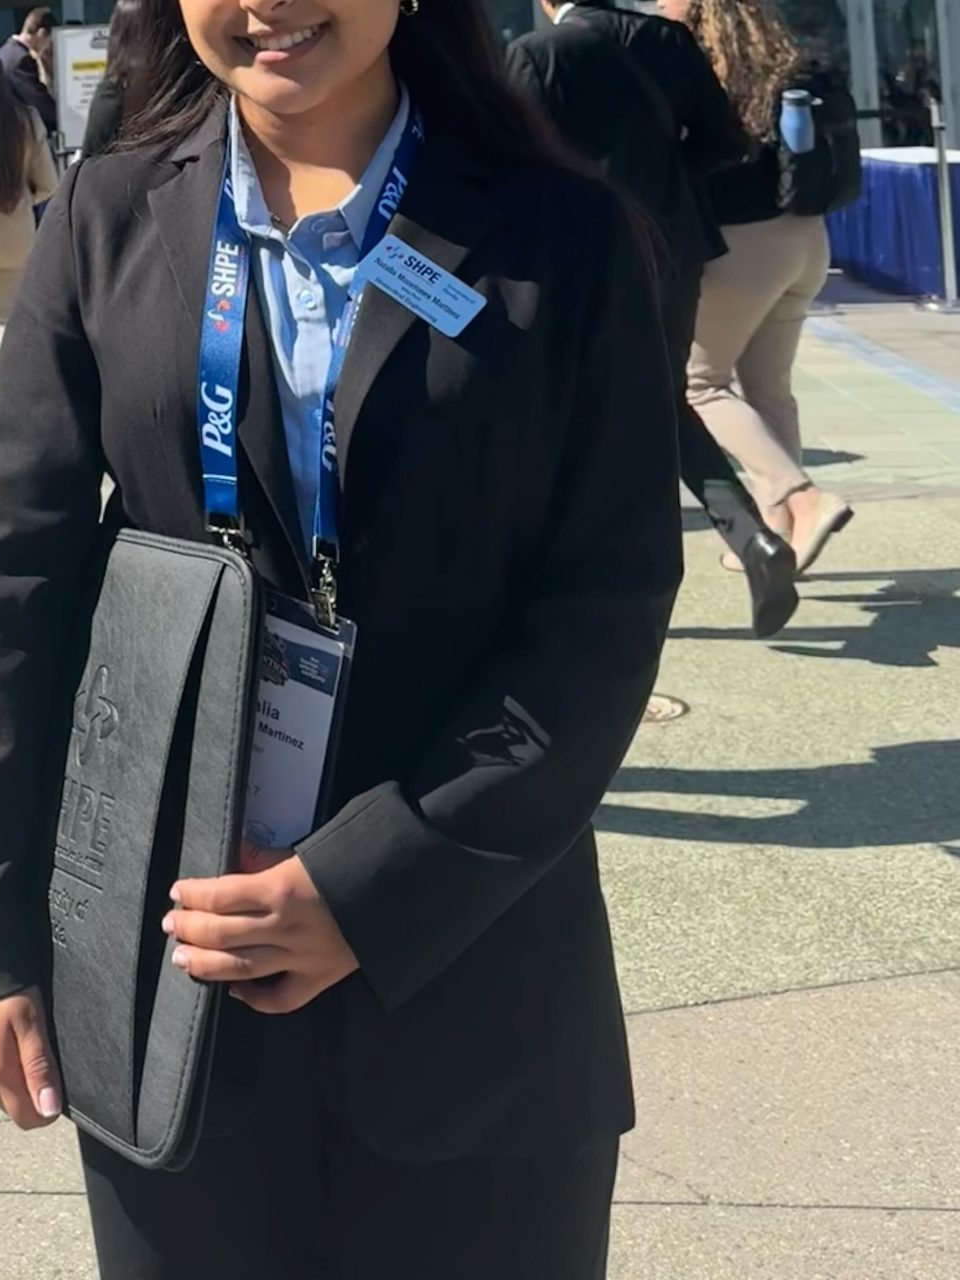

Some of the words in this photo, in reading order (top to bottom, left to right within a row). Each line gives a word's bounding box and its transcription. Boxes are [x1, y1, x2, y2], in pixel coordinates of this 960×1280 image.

[212, 239, 239, 298] SHPE
[403, 254, 443, 285] SHPE
[201, 381, 233, 458] P&G
[258, 721, 304, 751] Martinez
